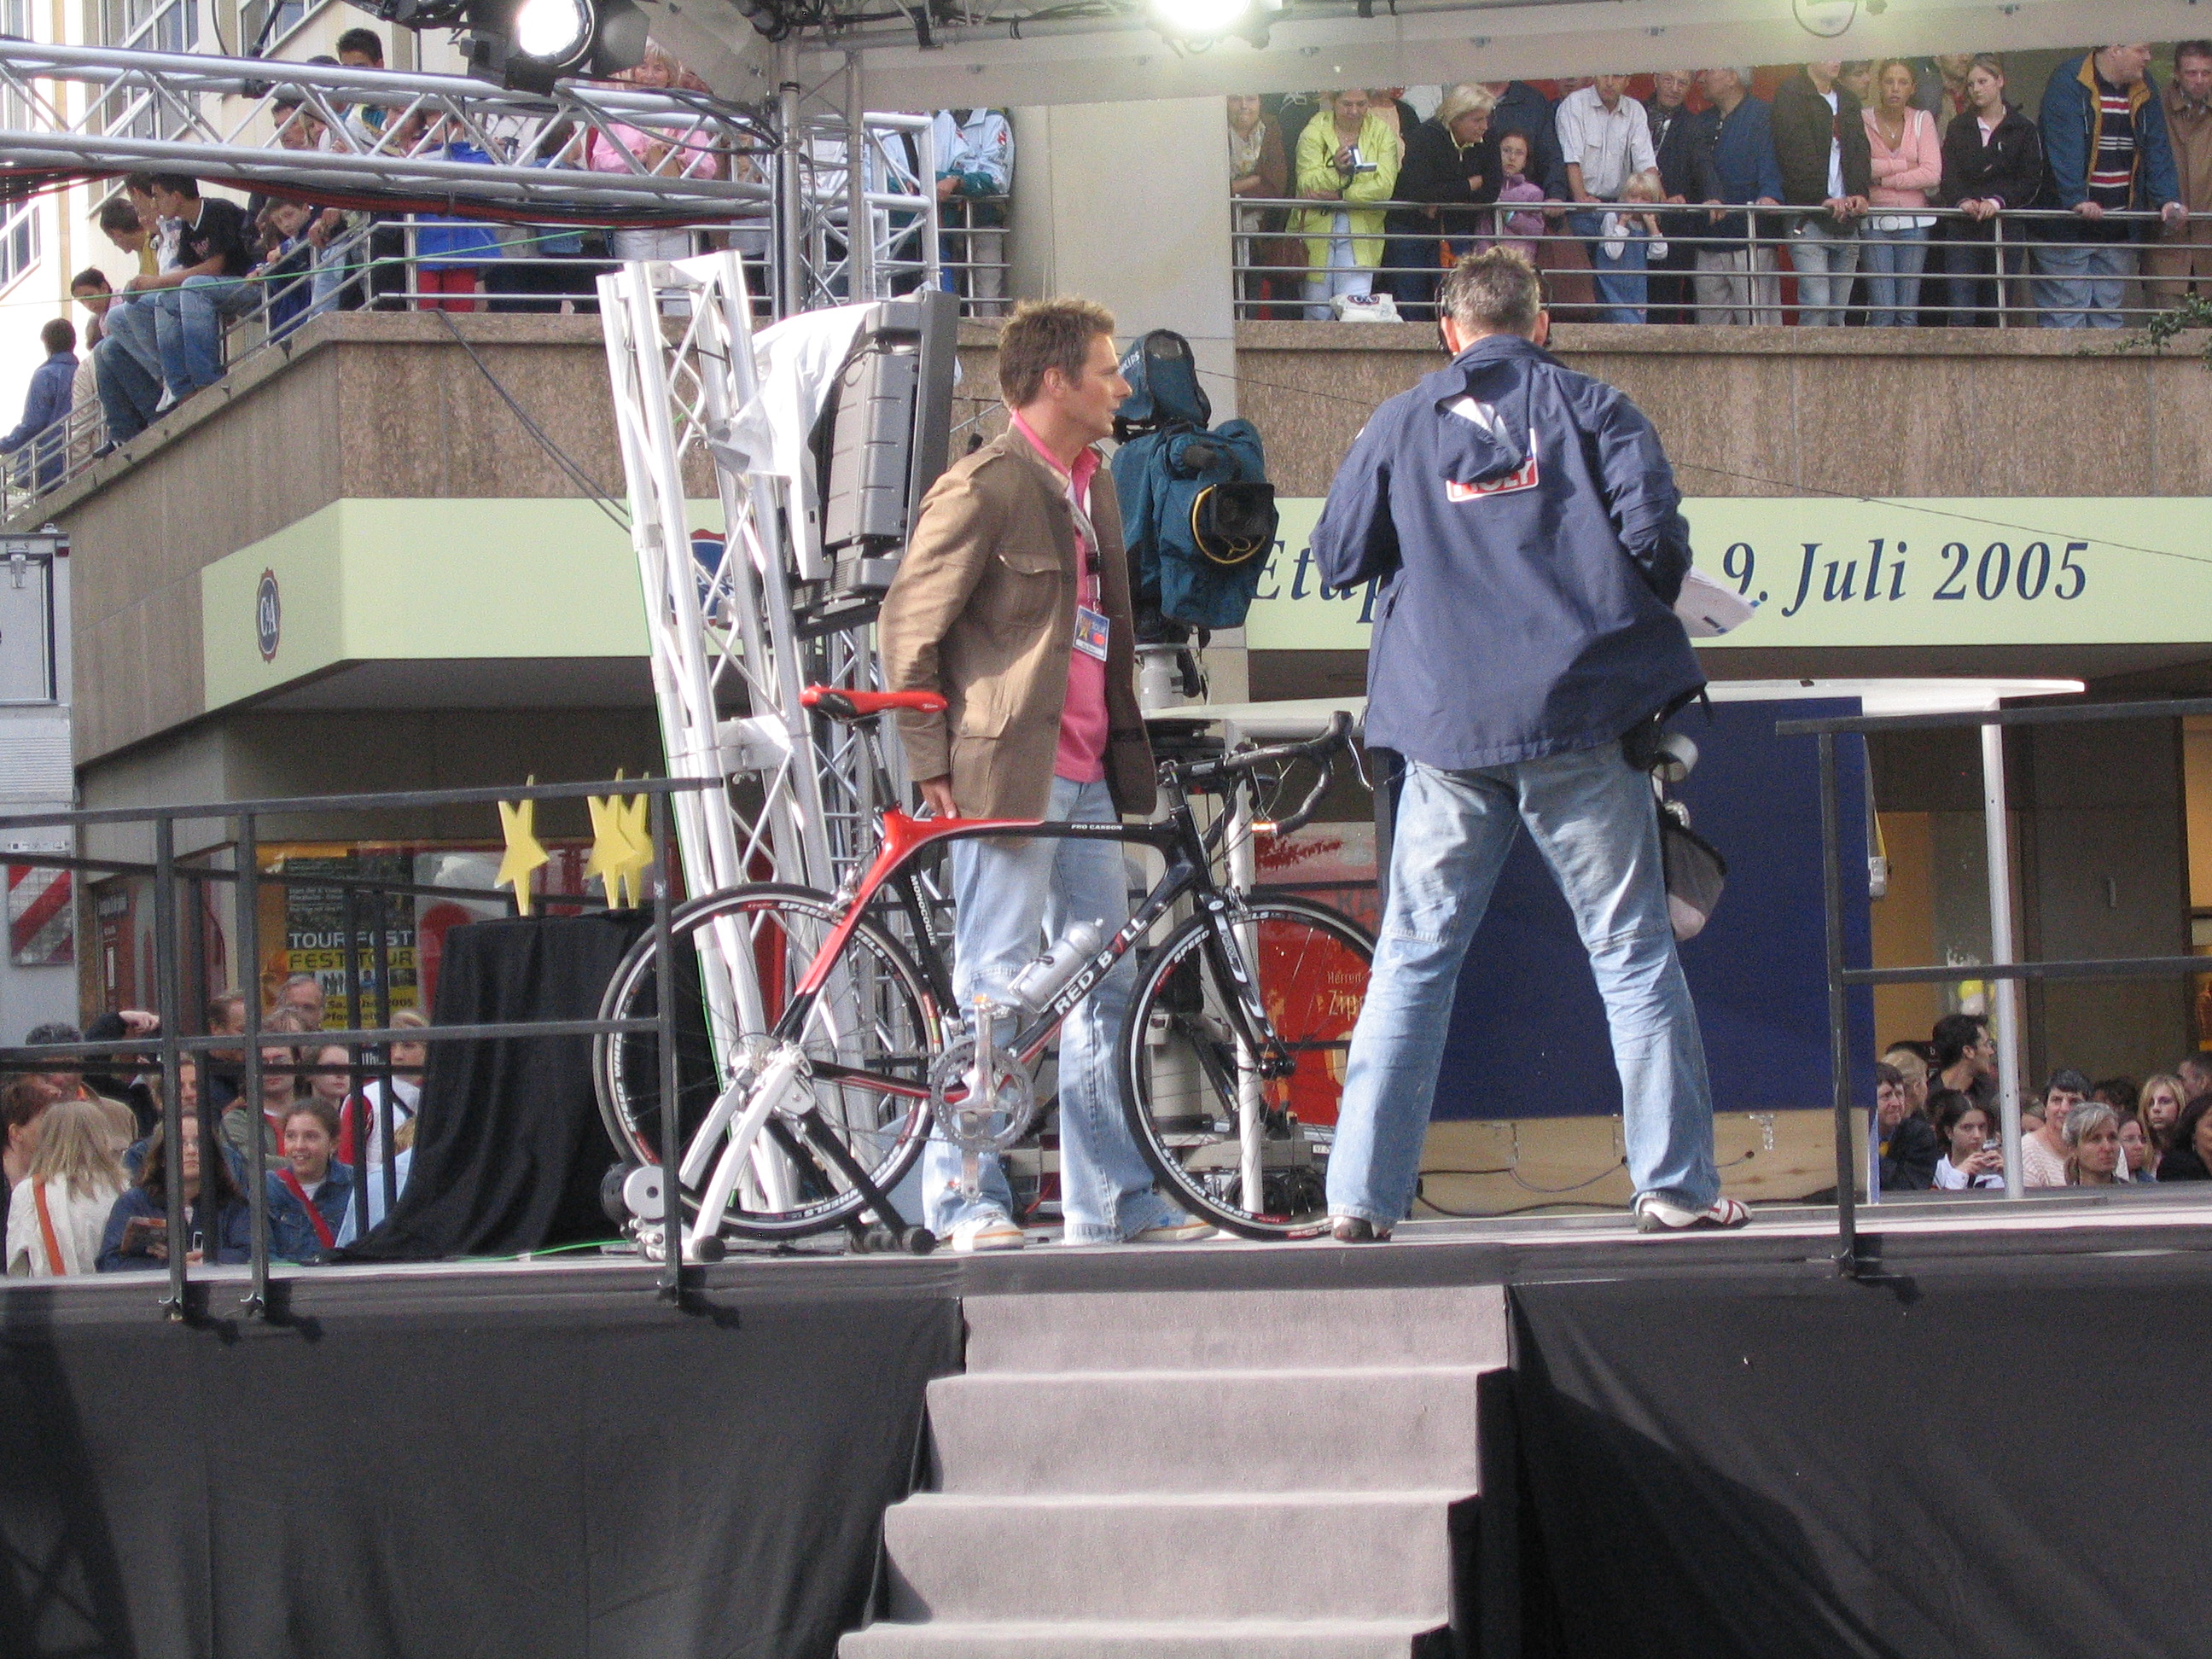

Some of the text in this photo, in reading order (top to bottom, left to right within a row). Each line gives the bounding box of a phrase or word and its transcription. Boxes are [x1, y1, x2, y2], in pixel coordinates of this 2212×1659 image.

[1723, 542, 1768, 602] 9.
[1781, 538, 1907, 617] Juli
[1932, 541, 2088, 600] 2005
[777, 901, 828, 919] SPEED
[910, 875, 937, 946] MONOCOQUE
[288, 929, 413, 949] TOUR FST
[290, 949, 413, 969] FEST TUR
[1173, 928, 1210, 963] SPEED
[1053, 969, 1095, 1016] RED
[616, 1081, 637, 1132] SPEED
[1161, 1148, 1254, 1220] SPEED WHEELS
